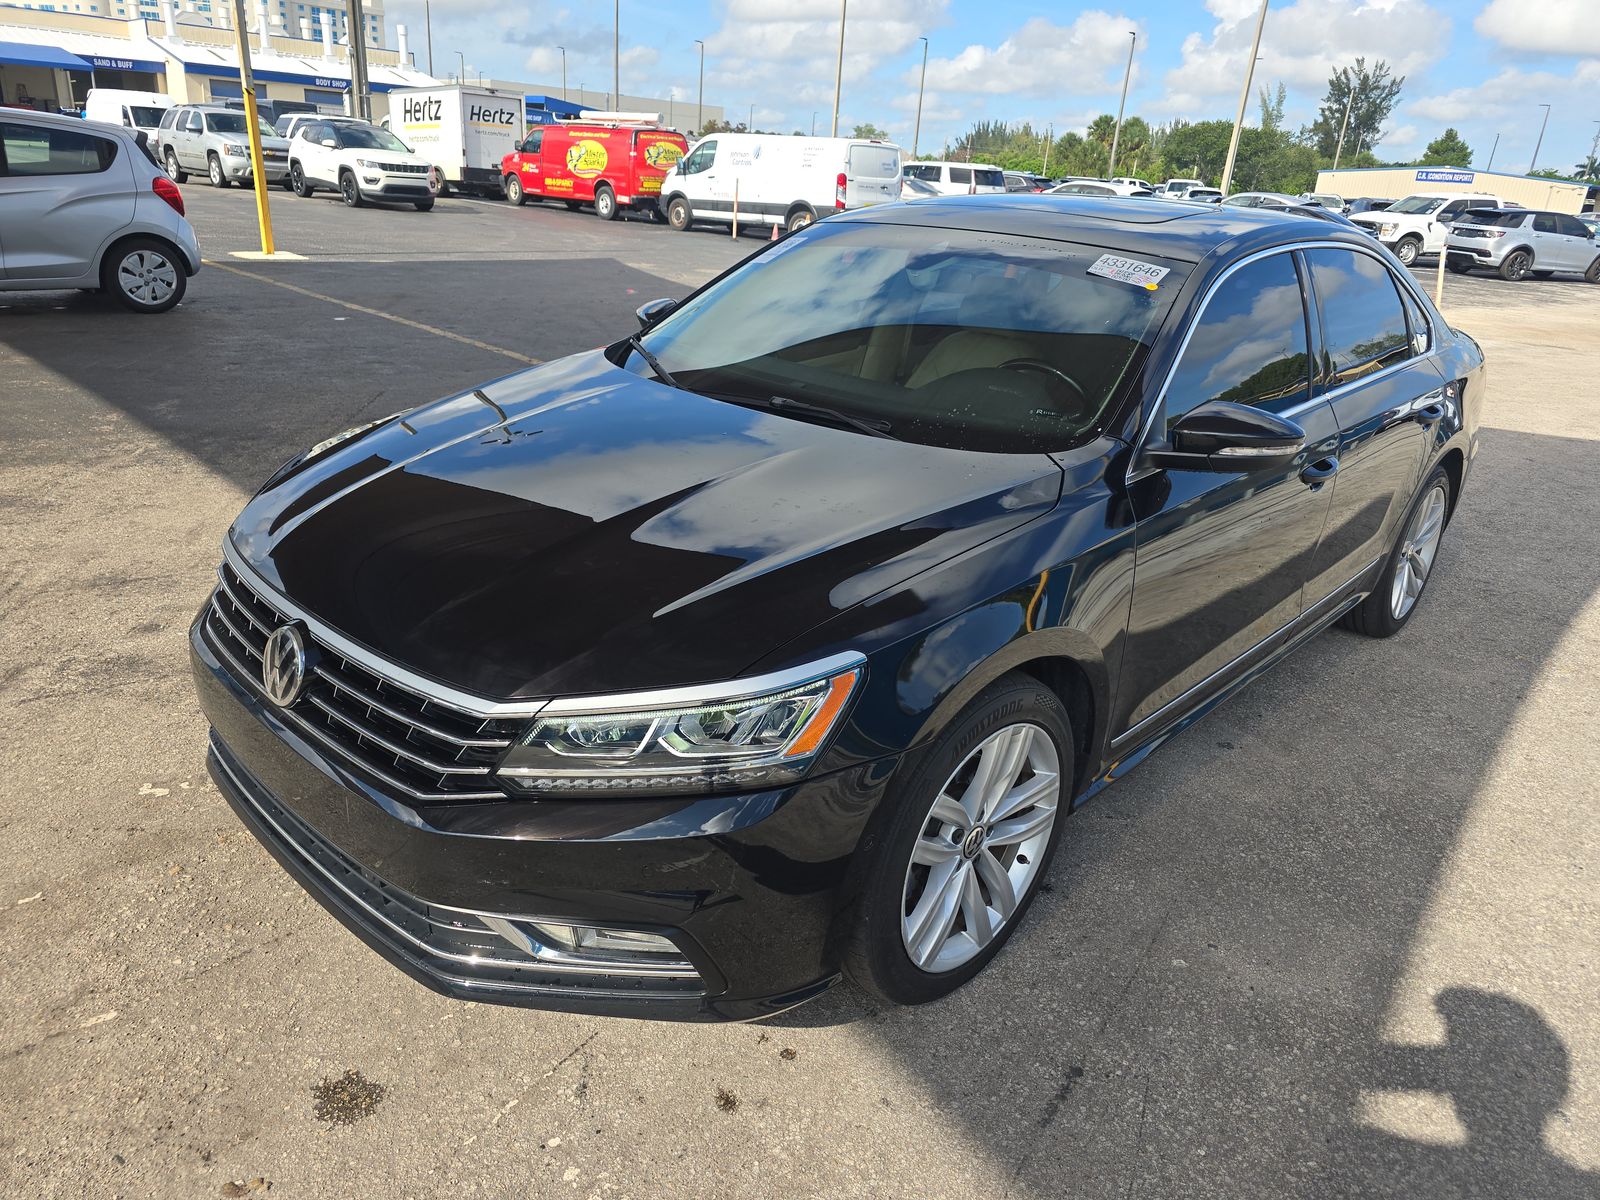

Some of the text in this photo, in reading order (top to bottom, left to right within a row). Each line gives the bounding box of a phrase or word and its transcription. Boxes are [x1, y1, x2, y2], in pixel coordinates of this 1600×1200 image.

[93, 58, 110, 66] SAND
[315, 78, 347, 88] BODY SHOP
[403, 95, 442, 123] Hertz
[470, 105, 515, 125] Hertz
[586, 149, 605, 158] Mister
[583, 158, 605, 168] Sparky
[1100, 256, 1162, 278] 4331646
